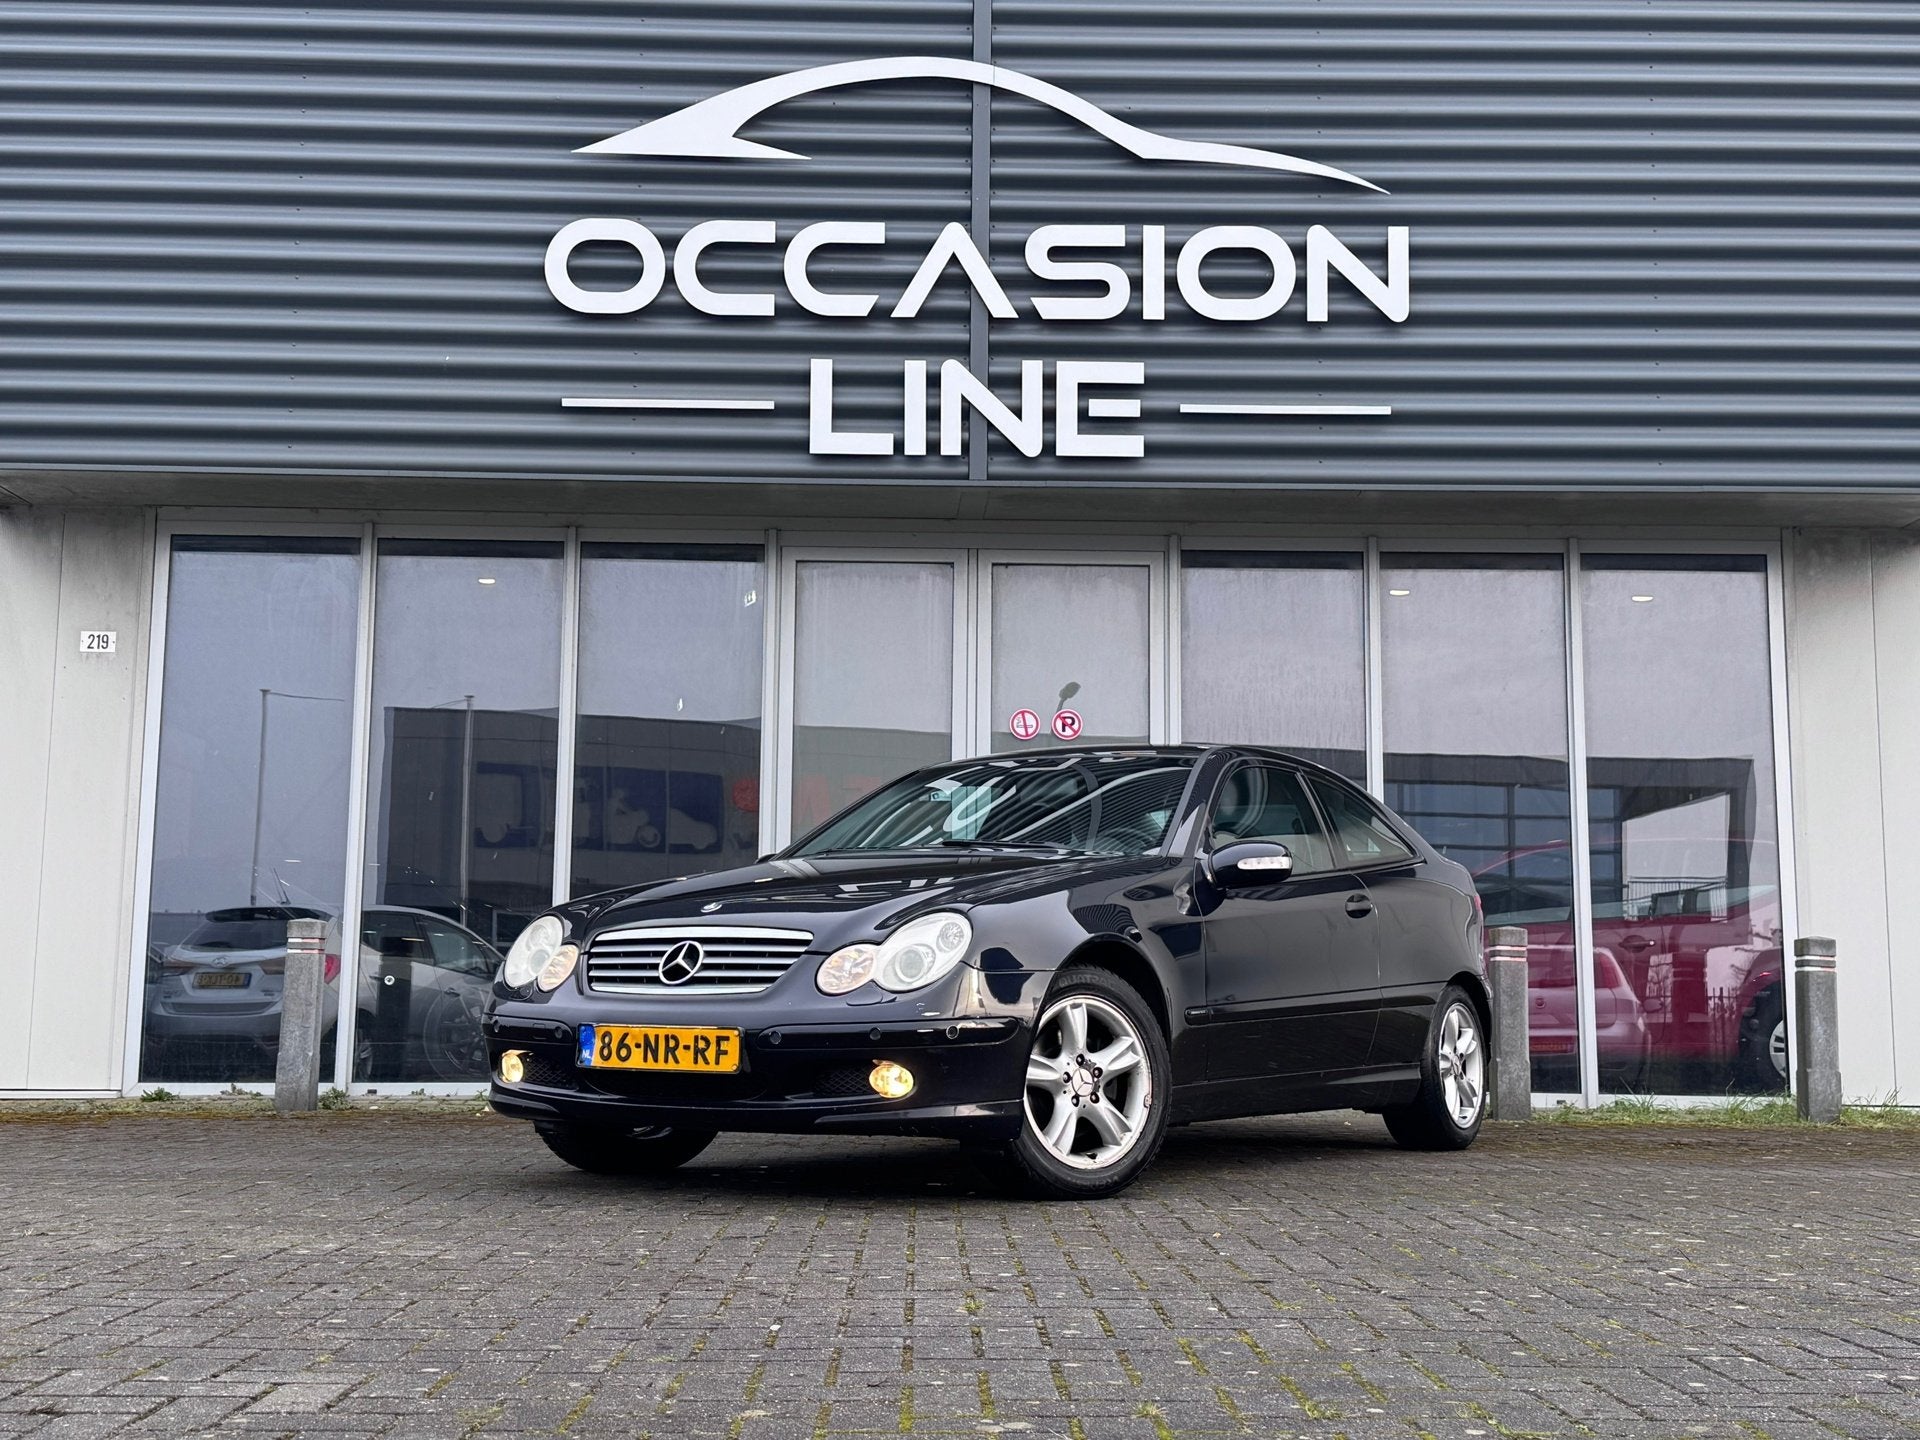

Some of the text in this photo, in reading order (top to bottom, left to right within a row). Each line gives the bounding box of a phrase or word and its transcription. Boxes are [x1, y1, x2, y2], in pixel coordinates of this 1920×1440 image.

[544, 217, 1411, 323] OCCASION
[809, 358, 1146, 458] LINE
[87, 634, 109, 650] 219
[581, 1030, 731, 1066] NL 86-NR-RF
